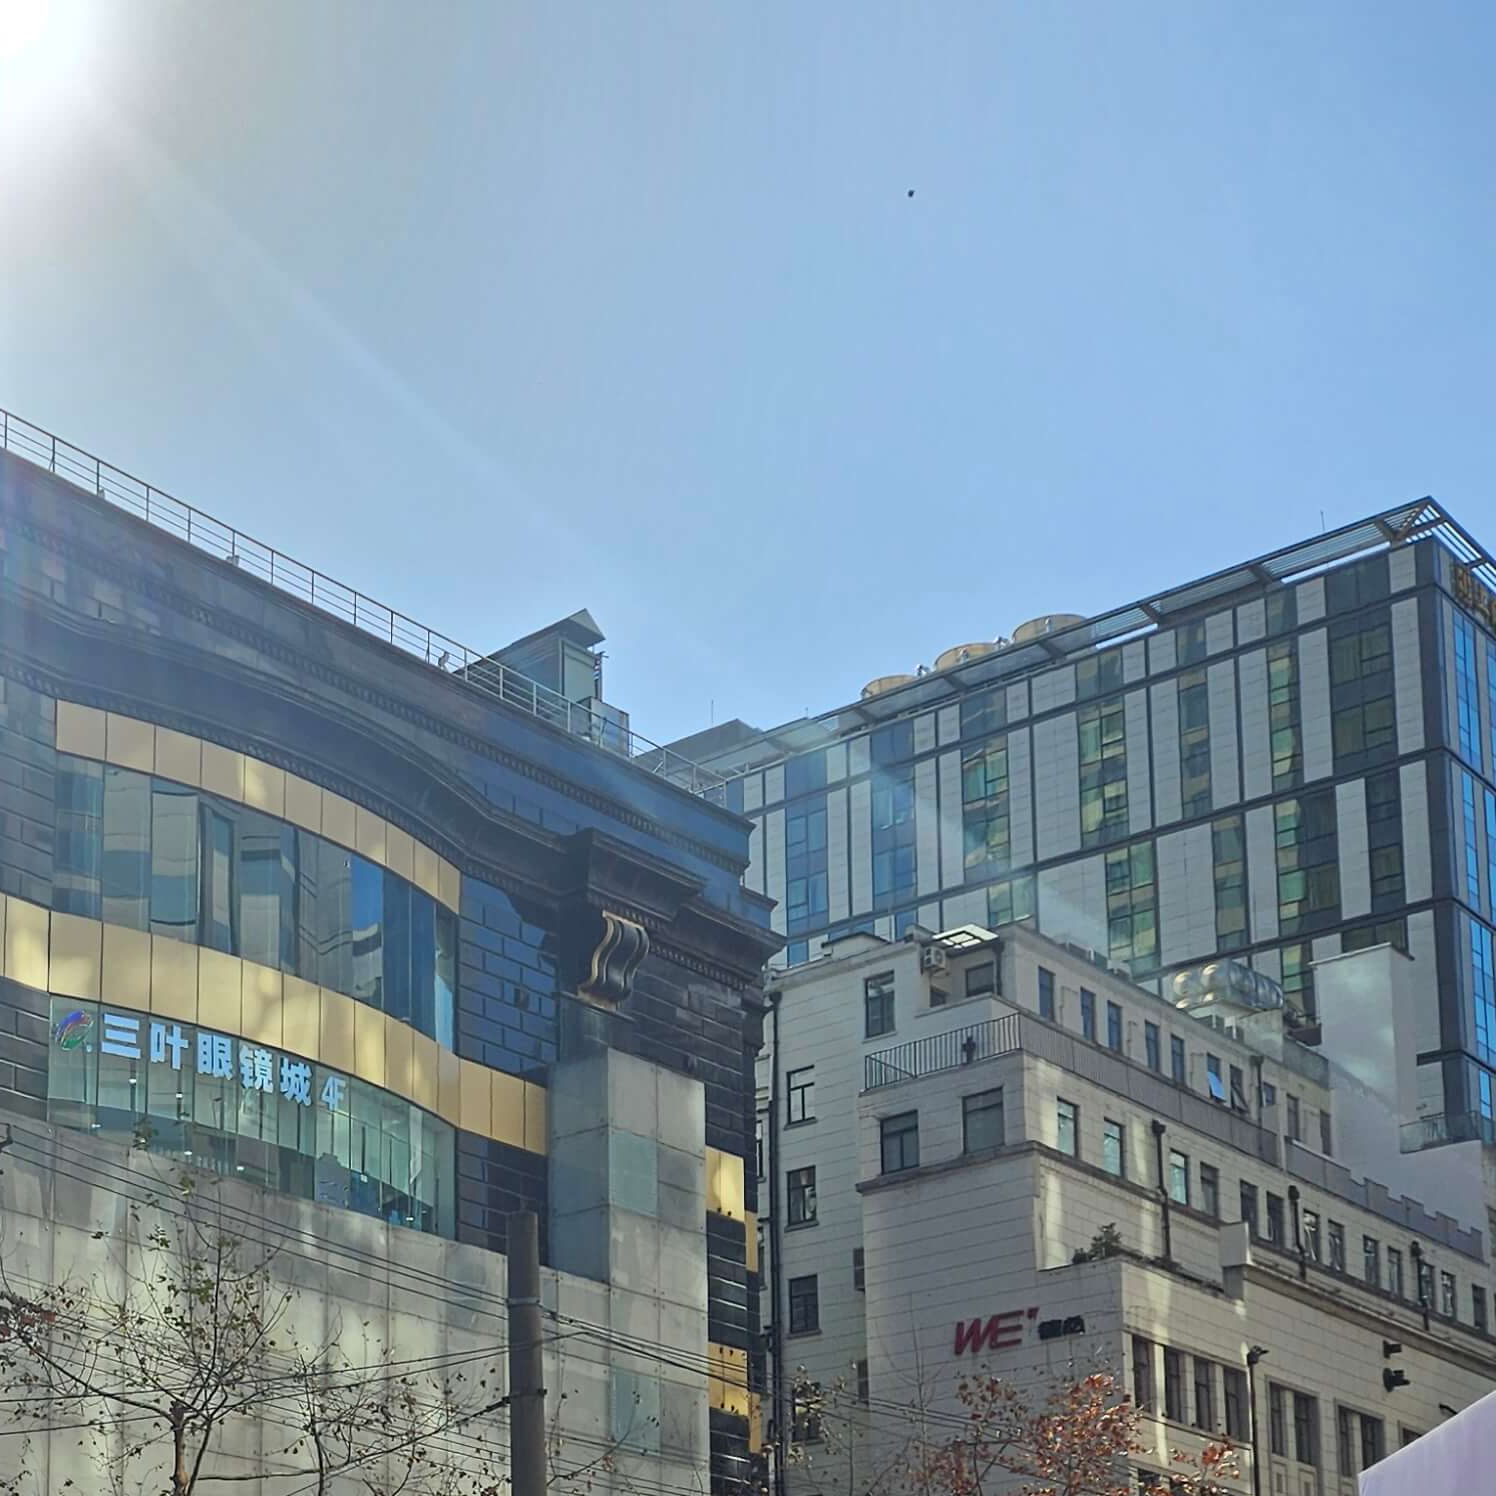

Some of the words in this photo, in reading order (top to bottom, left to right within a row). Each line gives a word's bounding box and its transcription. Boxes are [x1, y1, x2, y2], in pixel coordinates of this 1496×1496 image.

[100, 1012, 313, 1108] 三叶眼镜城
[320, 1075, 346, 1111] 4F
